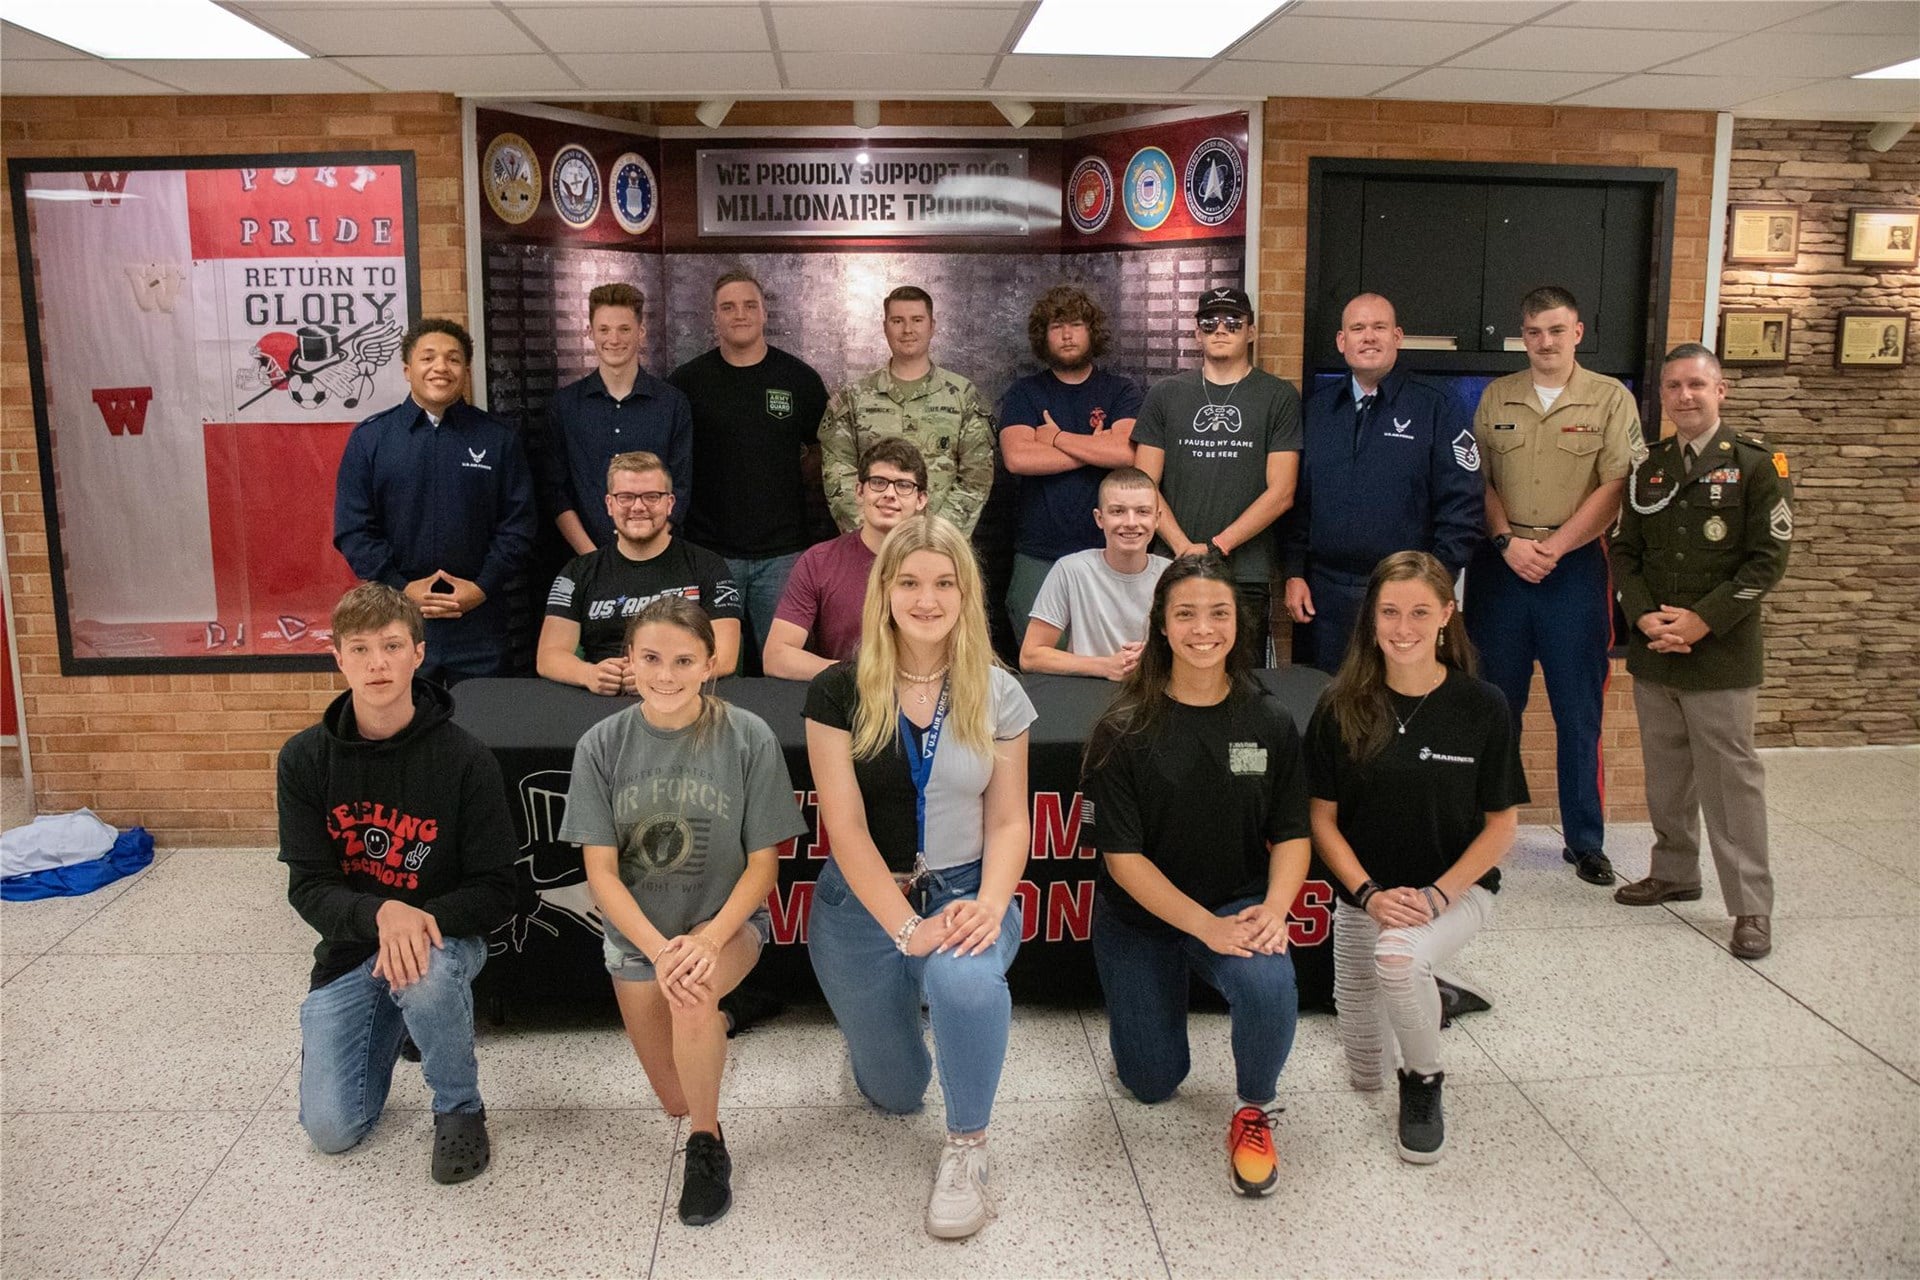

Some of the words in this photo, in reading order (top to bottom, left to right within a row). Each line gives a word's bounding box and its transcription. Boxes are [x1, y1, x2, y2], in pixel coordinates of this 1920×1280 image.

[716, 163, 750, 186] WE
[756, 163, 853, 186] PROUDLY
[860, 163, 960, 186] SUPPORT
[716, 194, 896, 222] MILLIONAIRE
[240, 216, 393, 246] PRIDE
[245, 267, 354, 287] RETURN
[363, 266, 396, 286] TO
[245, 293, 397, 326] GLORY
[92, 386, 153, 437] W
[1184, 438, 1216, 448] PAUSED
[1230, 440, 1254, 448] GAME
[1192, 450, 1203, 458] TO
[588, 599, 617, 621] US
[928, 732, 938, 747] U.S.
[933, 717, 942, 731] AIR
[652, 777, 731, 820] FORCE
